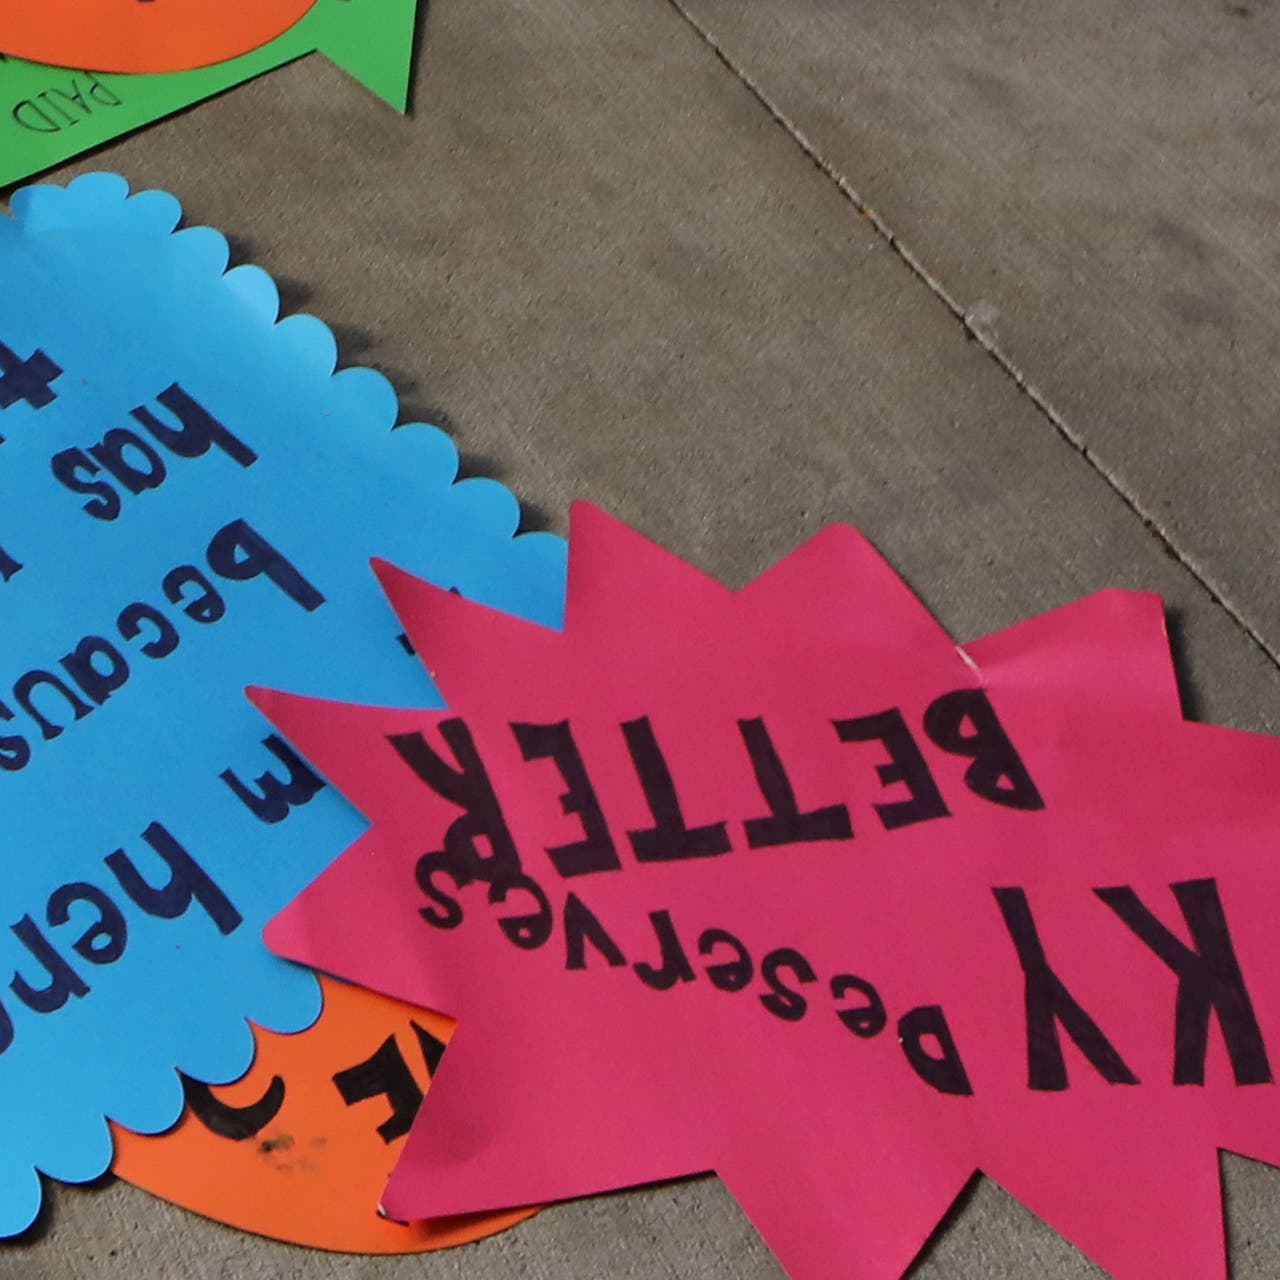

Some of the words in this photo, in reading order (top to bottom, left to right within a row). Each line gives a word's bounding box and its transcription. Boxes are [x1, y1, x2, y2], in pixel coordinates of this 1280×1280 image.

[12, 71, 123, 134] PAID
[51, 383, 258, 523] has
[385, 688, 1044, 882] BETTER
[414, 850, 972, 1096] Deserves
[991, 878, 1274, 1092] KY
